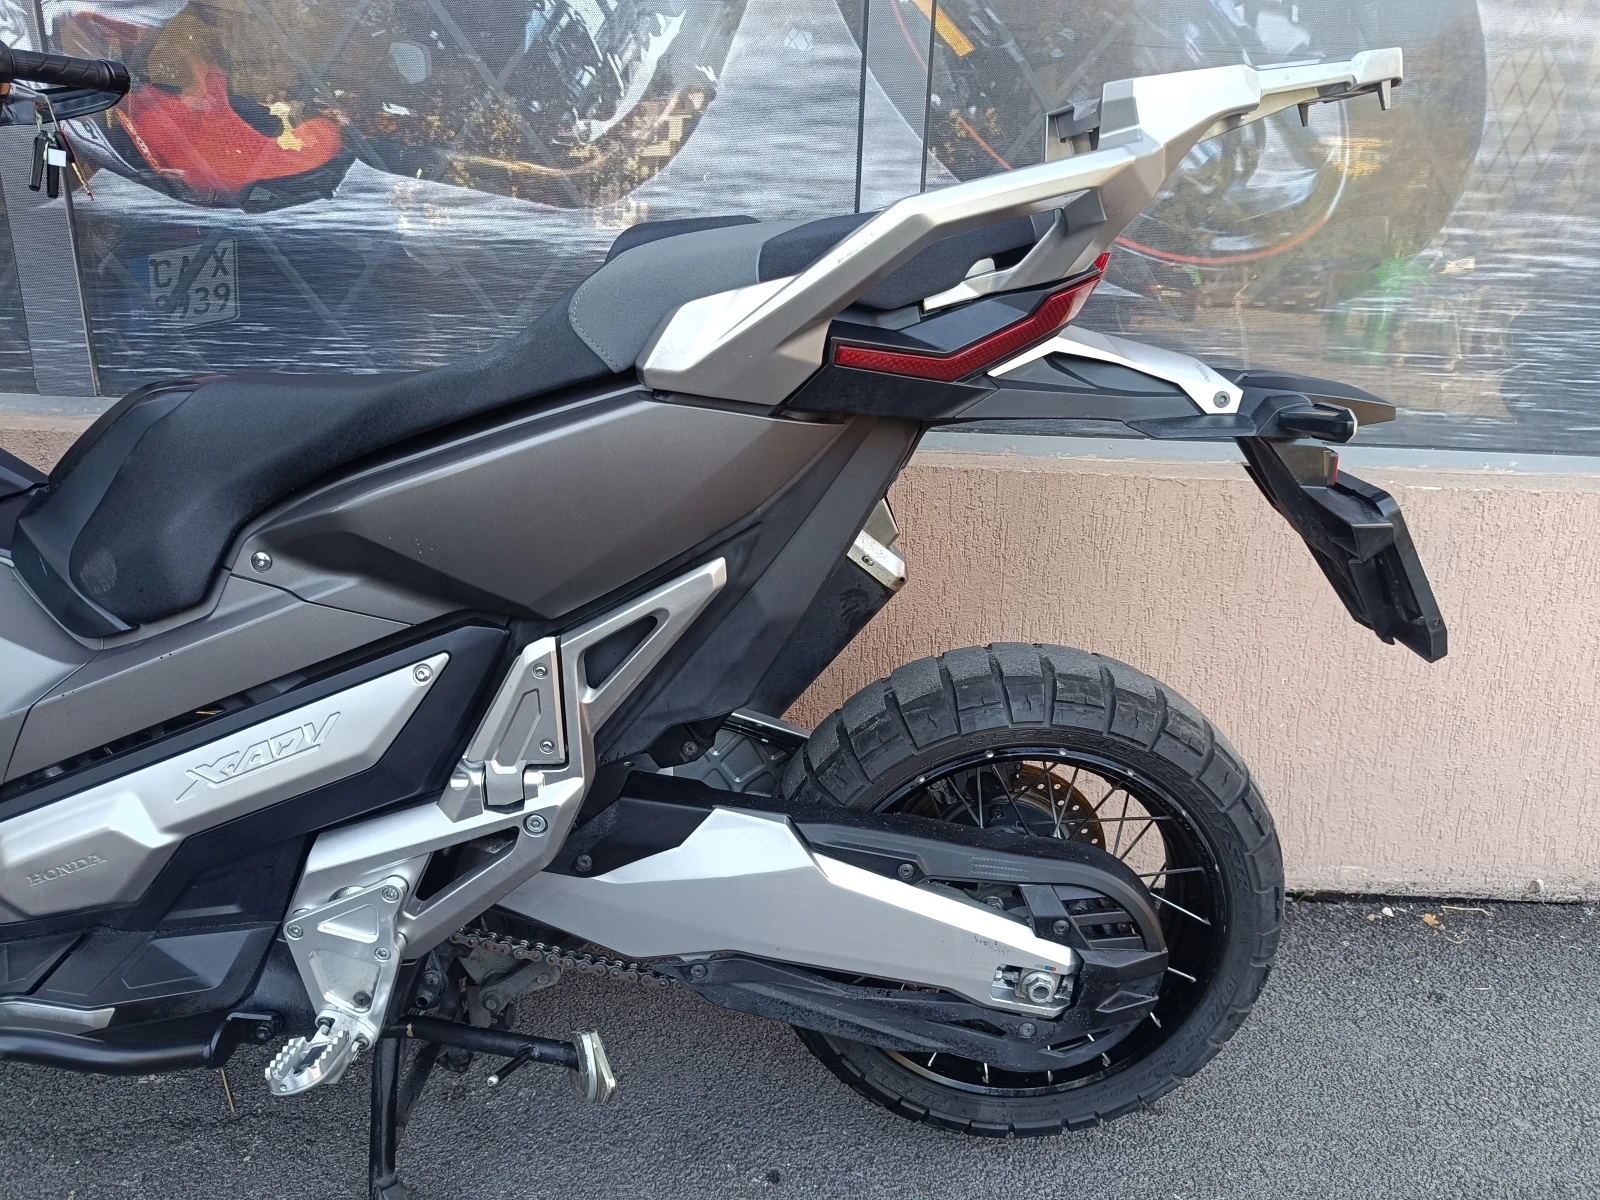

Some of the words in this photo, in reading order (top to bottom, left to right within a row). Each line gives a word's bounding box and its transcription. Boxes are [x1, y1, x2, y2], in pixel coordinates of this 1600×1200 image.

[26, 853, 107, 887] HONDA
[1153, 761, 1231, 838] RALLY
[1222, 836, 1251, 895] STR
